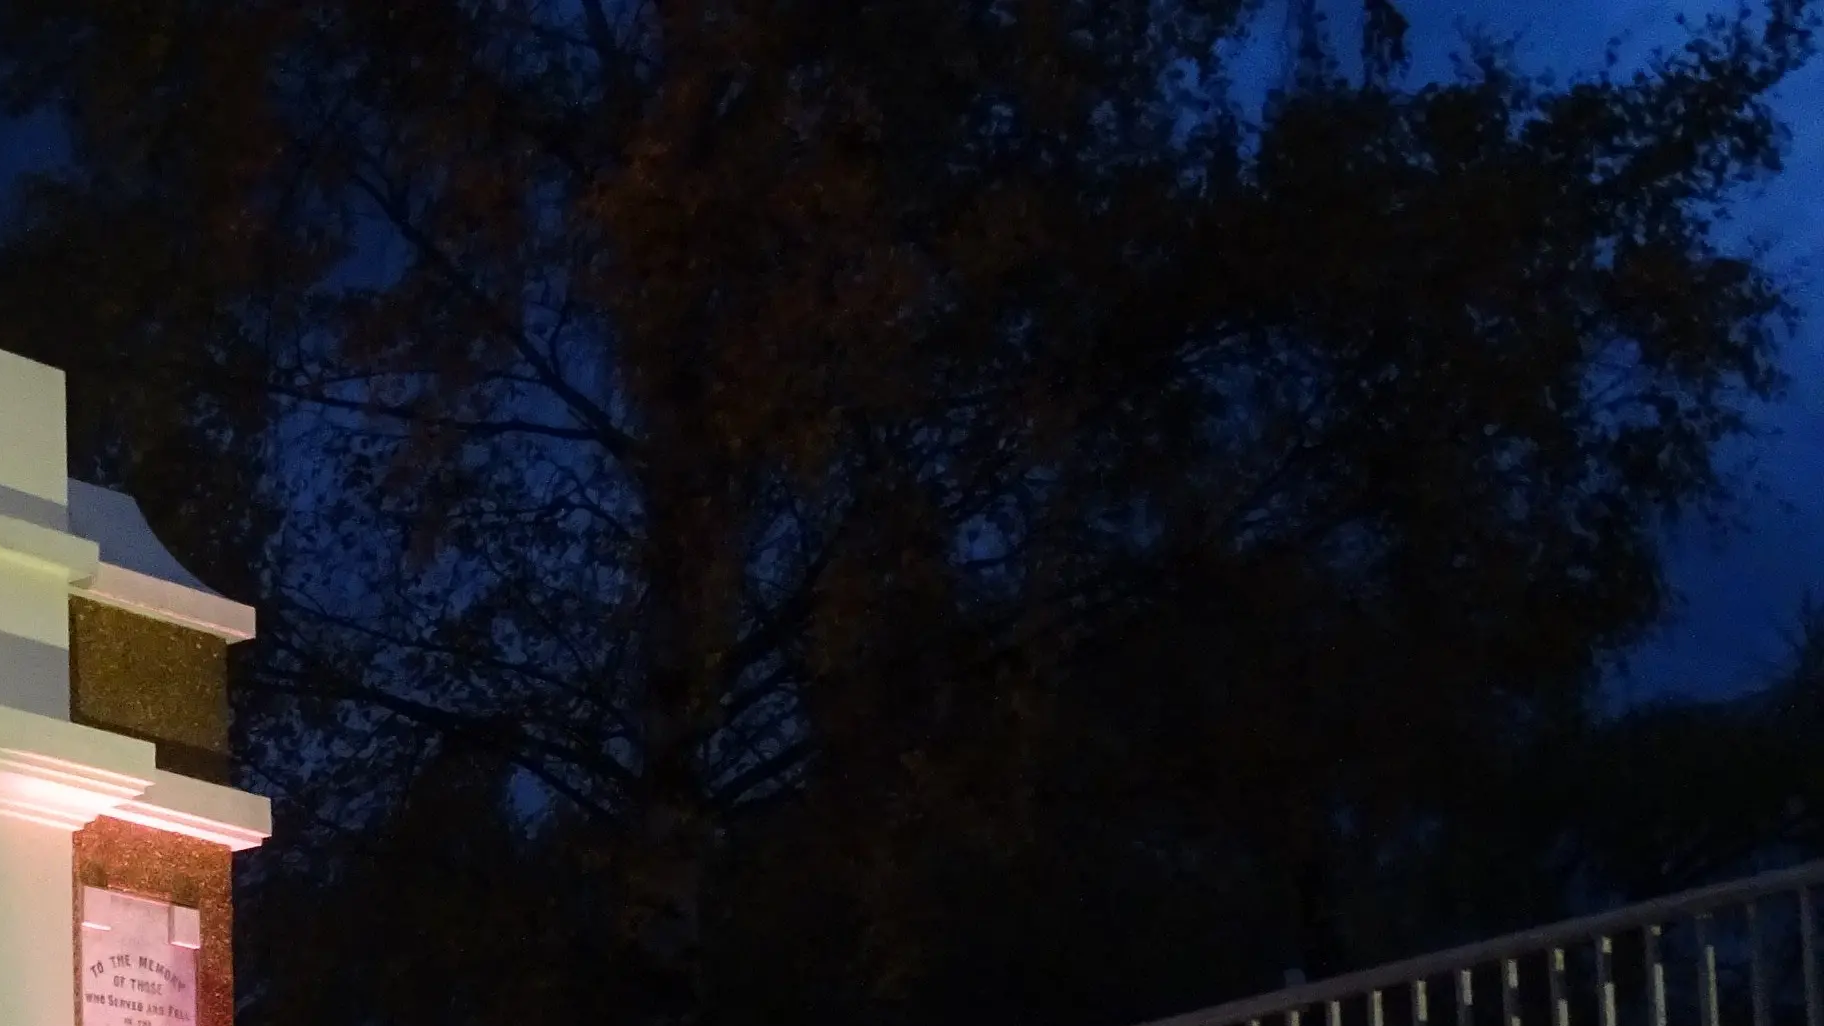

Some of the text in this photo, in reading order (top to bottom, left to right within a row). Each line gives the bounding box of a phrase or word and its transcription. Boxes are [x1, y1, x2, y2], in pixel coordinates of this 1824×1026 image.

[89, 959, 105, 979] TO
[108, 953, 132, 968] THE
[113, 975, 163, 996] OF THOSE
